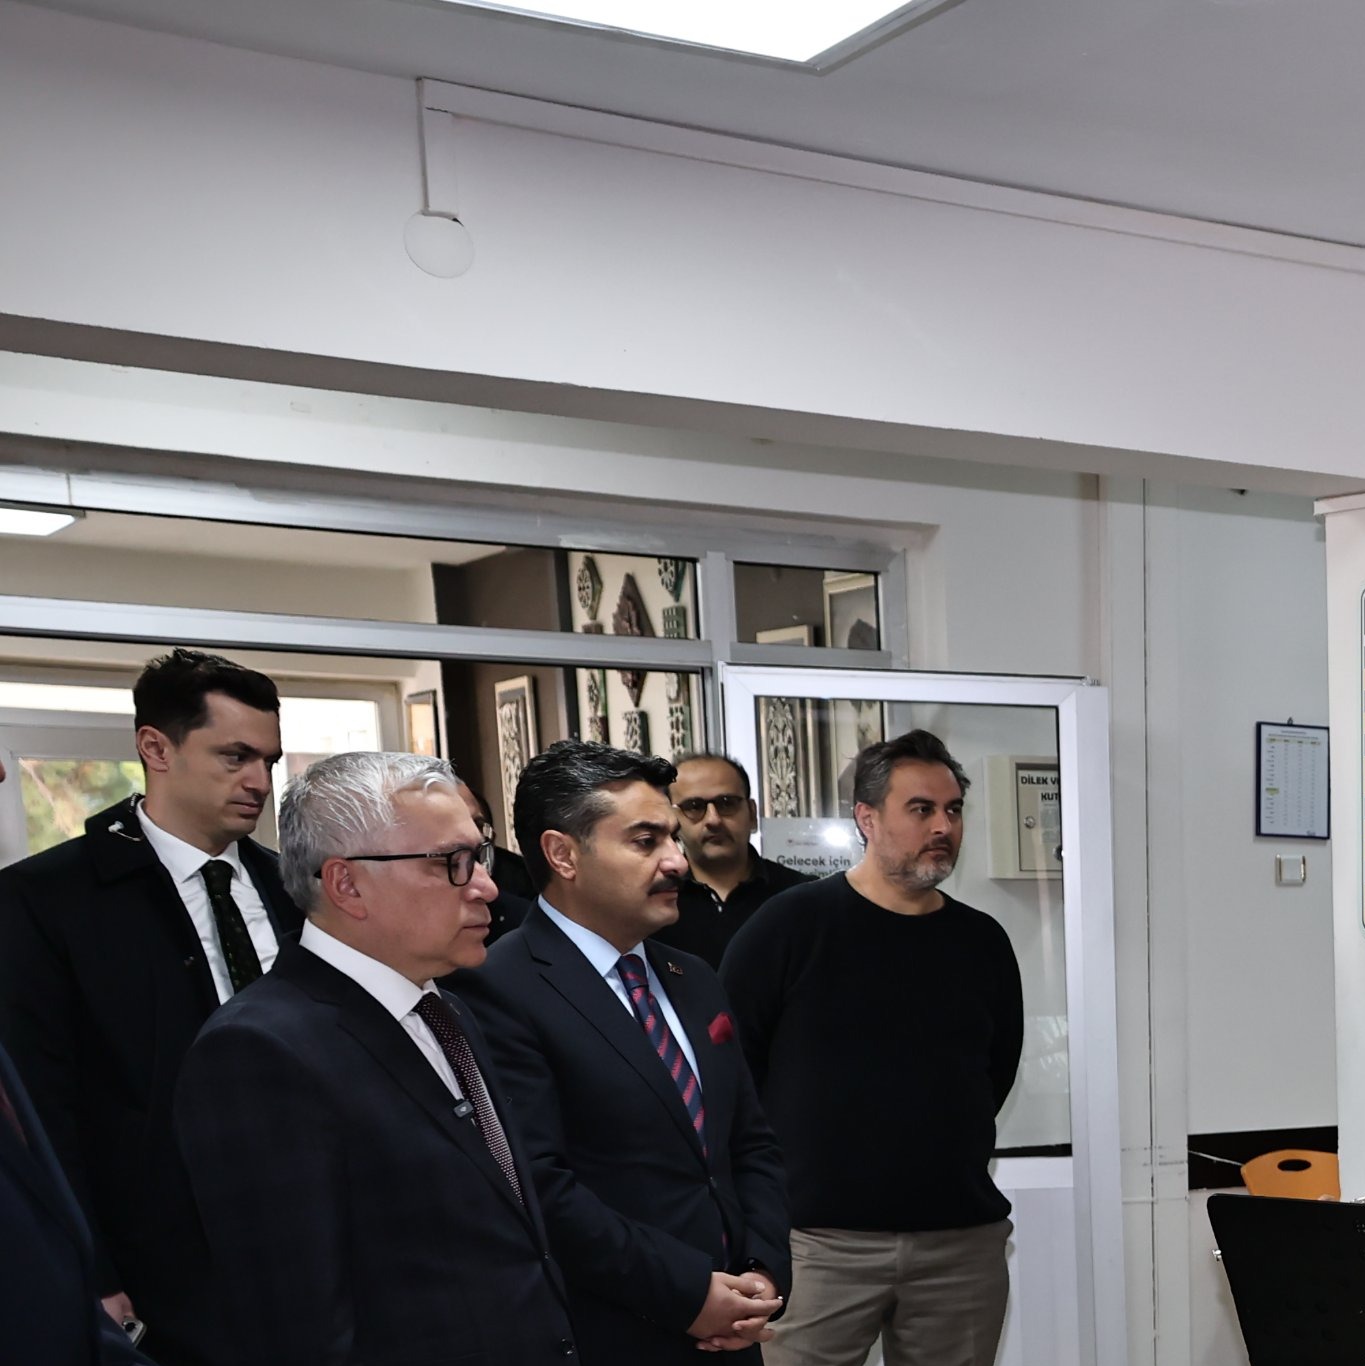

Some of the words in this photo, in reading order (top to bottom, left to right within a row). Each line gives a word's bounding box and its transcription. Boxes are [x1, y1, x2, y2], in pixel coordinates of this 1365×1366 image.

[1021, 774, 1048, 785] DİLEK
[776, 855, 826, 867] Gelecek
[829, 855, 851, 868] için
